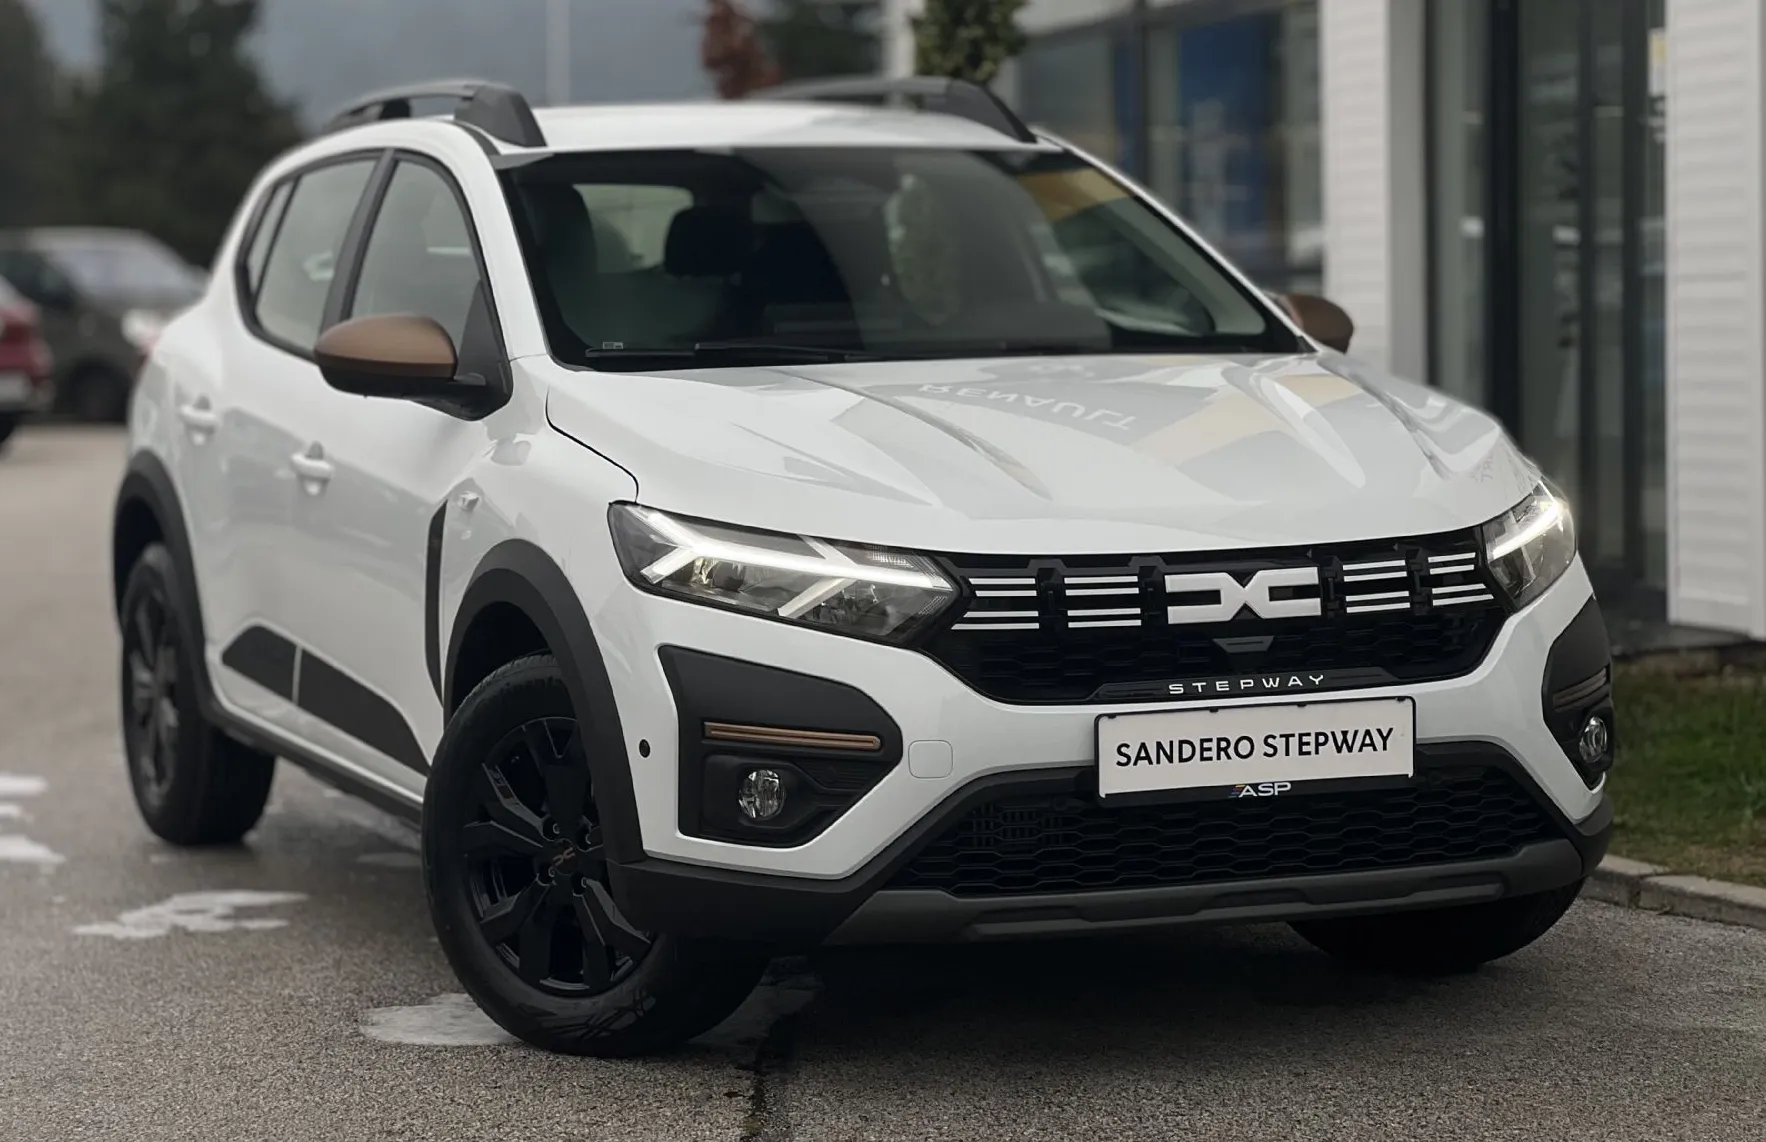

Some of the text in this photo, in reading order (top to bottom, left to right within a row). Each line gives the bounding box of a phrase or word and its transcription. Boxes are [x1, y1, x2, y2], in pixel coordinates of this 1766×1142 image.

[1168, 674, 1325, 695] STEPWAY
[1115, 727, 1395, 767] SANDERO STEPWAY
[1238, 782, 1292, 798] ASP
